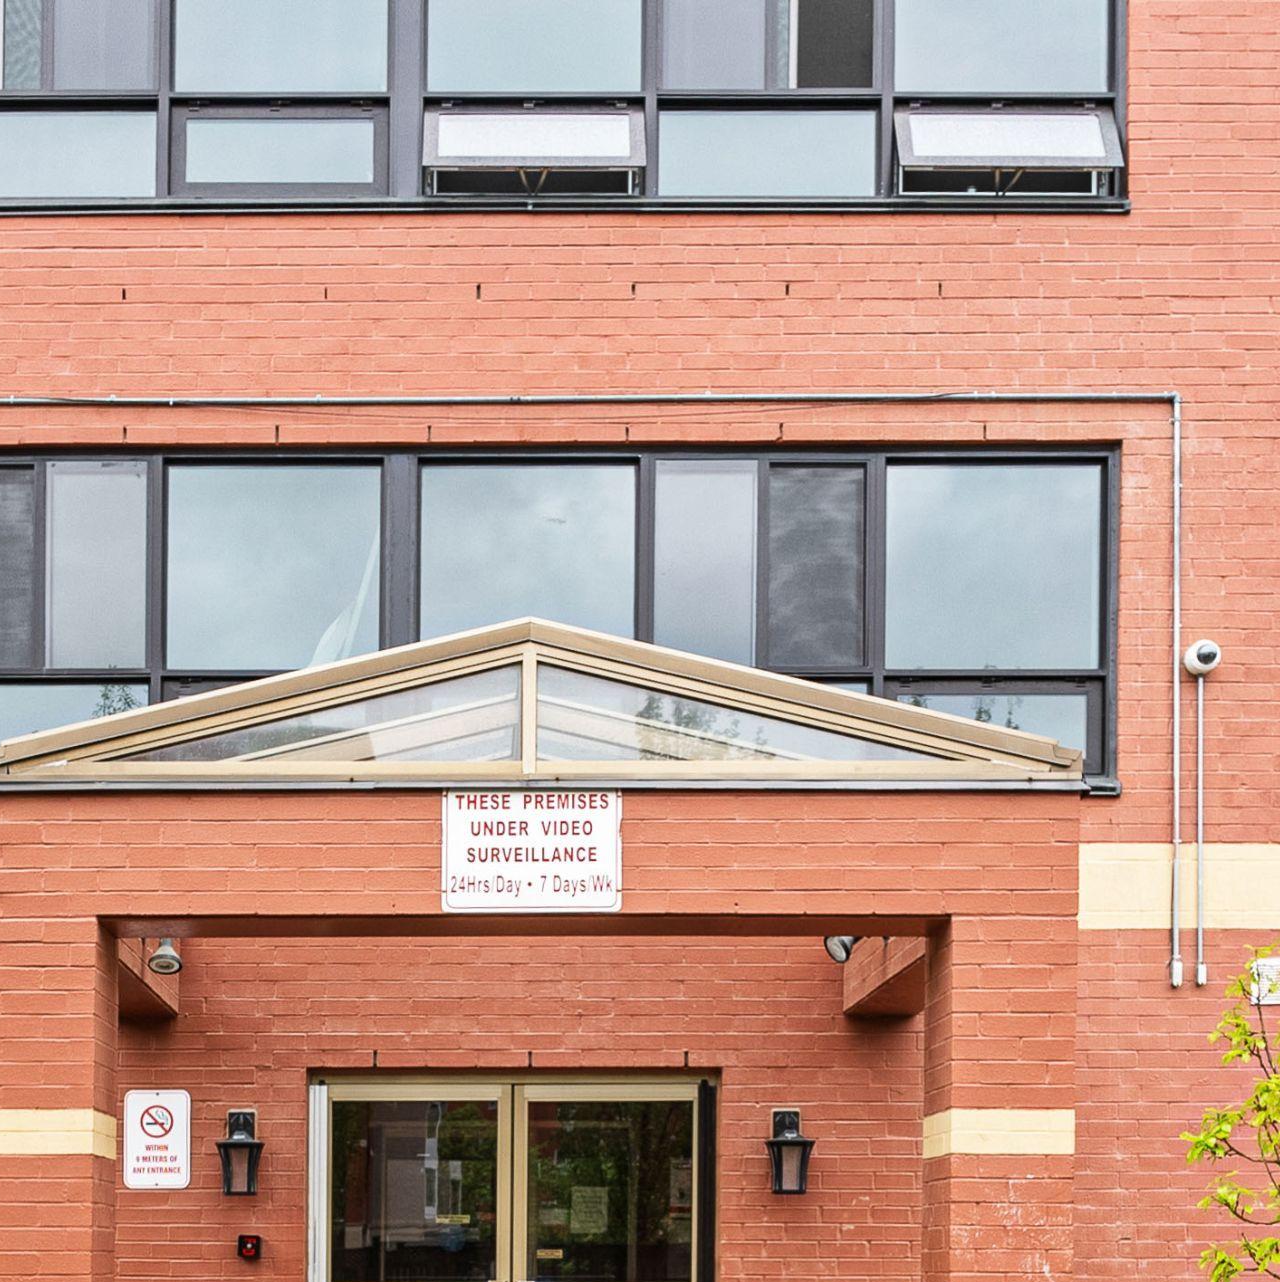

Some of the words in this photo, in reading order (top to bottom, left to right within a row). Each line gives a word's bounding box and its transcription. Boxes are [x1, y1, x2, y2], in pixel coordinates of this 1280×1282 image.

[455, 793, 511, 810] THESE
[523, 793, 609, 810] PREMISES
[470, 820, 529, 837] UNDER
[541, 820, 593, 836] VIDEO
[466, 846, 598, 863] SURVEILLANCE
[540, 875, 547, 893] 7
[142, 1155, 168, 1163] METERS
[169, 1155, 178, 1163] OF
[147, 1166, 181, 1174] ENTRANCE
